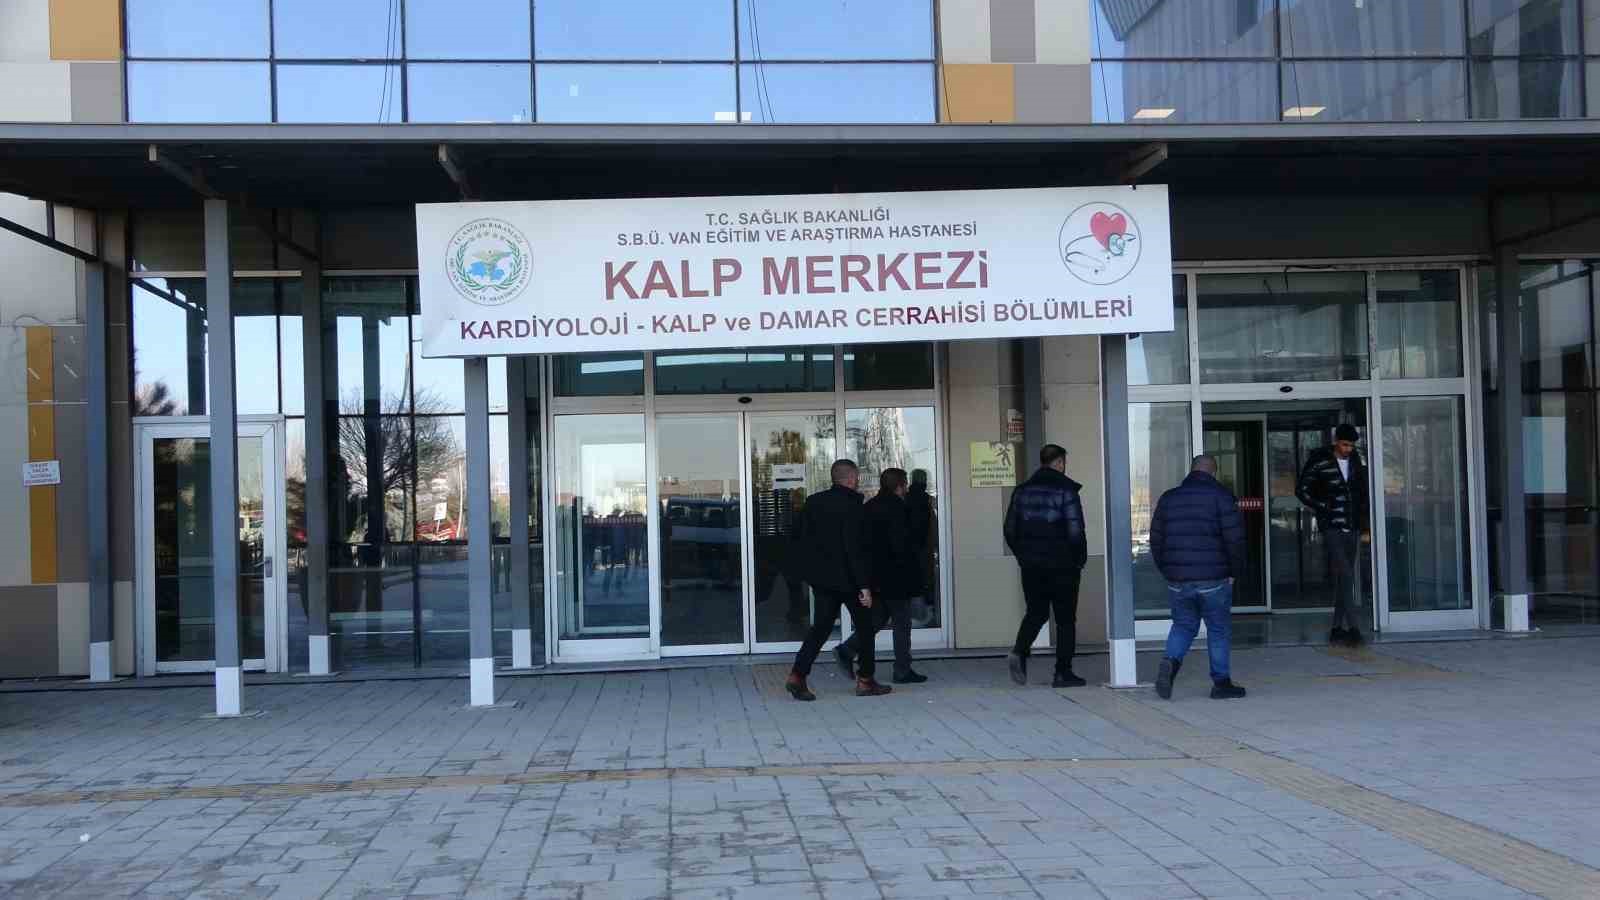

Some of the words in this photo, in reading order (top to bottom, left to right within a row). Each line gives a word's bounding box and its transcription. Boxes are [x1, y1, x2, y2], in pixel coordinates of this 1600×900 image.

[617, 230, 664, 246] S.B.Ü.
[668, 231, 701, 245] VAN
[706, 227, 760, 244] EĞİTİM
[765, 229, 786, 242] VE
[790, 226, 884, 243] ARAŞTIRMA
[889, 220, 977, 239] HASTANESİ
[704, 212, 734, 226] T.C.
[738, 208, 799, 226] SAĞLIK
[803, 206, 890, 224] BAKANLIĞI
[604, 257, 743, 301] KALP
[761, 249, 989, 297] MERKEZİ
[460, 312, 629, 341] KARDİYOLOJİ
[651, 313, 717, 334] KALP
[723, 316, 752, 332] ve
[759, 308, 849, 331] DAMAR
[855, 299, 986, 328] CERRAHİSİ
[993, 294, 1133, 322] BÖLÜMLERİ
